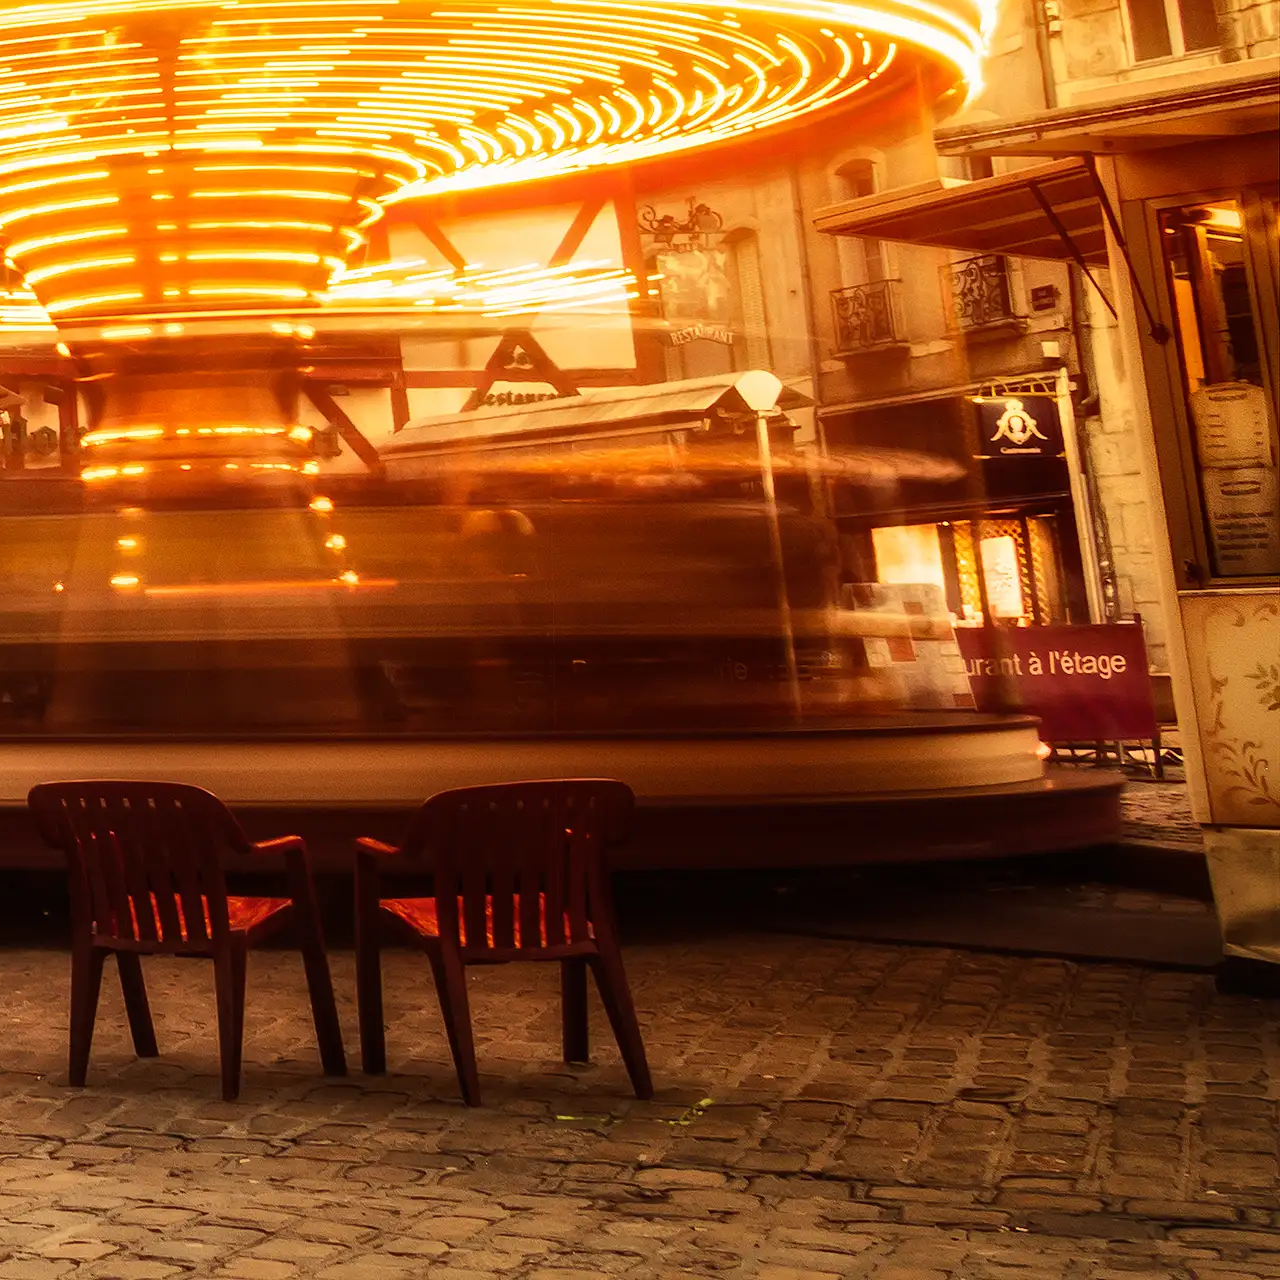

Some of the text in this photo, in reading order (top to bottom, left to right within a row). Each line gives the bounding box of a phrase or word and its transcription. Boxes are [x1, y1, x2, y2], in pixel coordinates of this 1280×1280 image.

[669, 325, 735, 345] RESTAURANT
[1028, 652, 1043, 676] à
[1048, 651, 1128, 679] l'étage
